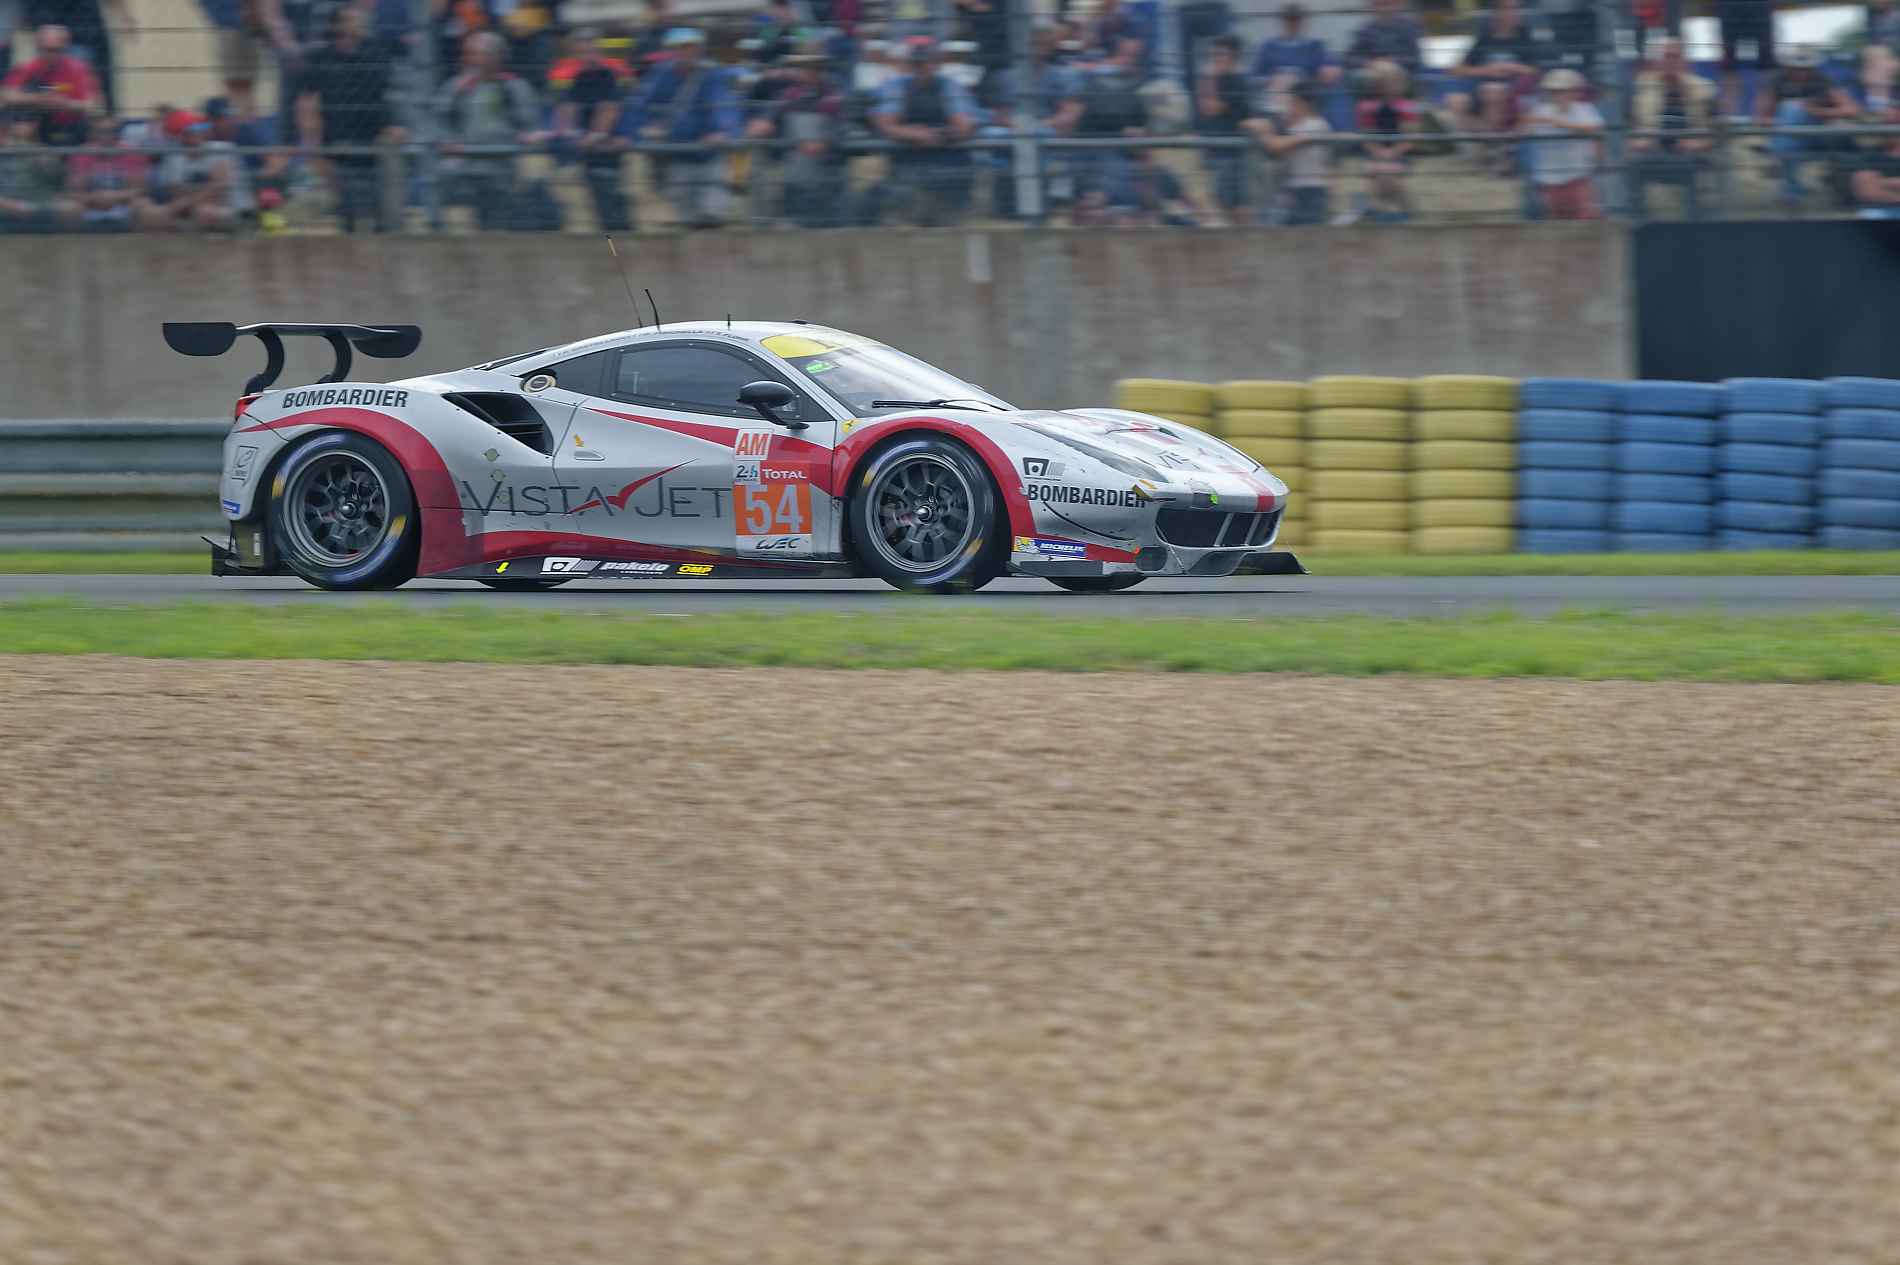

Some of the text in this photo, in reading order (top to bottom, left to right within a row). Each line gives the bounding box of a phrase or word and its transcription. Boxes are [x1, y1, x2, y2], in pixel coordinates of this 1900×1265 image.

[281, 389, 409, 408] BOMBARDIER
[735, 432, 769, 456] AM
[761, 468, 808, 480] TOTAL
[463, 476, 733, 518] VISTA JET
[745, 484, 804, 534] 54
[755, 537, 801, 550] WEC
[599, 561, 671, 572] pakelo
